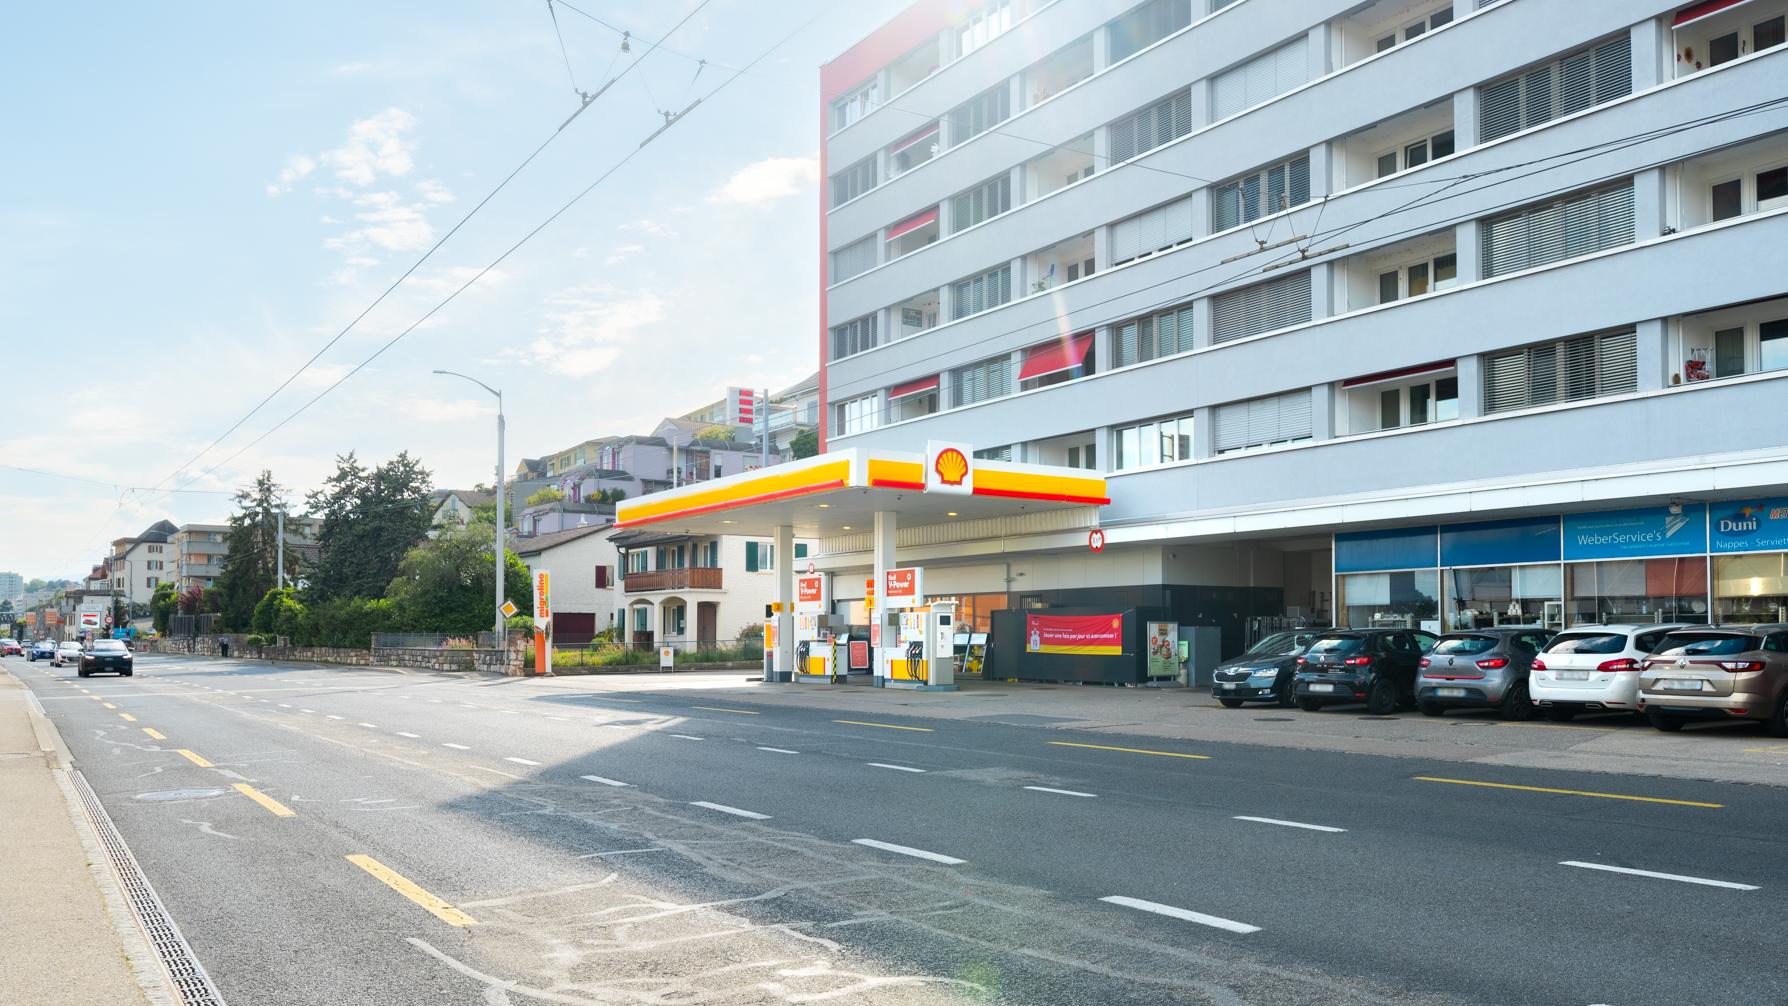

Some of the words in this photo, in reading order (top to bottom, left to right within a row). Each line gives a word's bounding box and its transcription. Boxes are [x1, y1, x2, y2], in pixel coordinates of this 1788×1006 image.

[1720, 517, 1757, 532] Duni
[1577, 529, 1662, 545] WeberService's
[1716, 540, 1748, 550] Nappes
[888, 580, 910, 589] V-Power
[537, 573, 546, 618] migrolino
